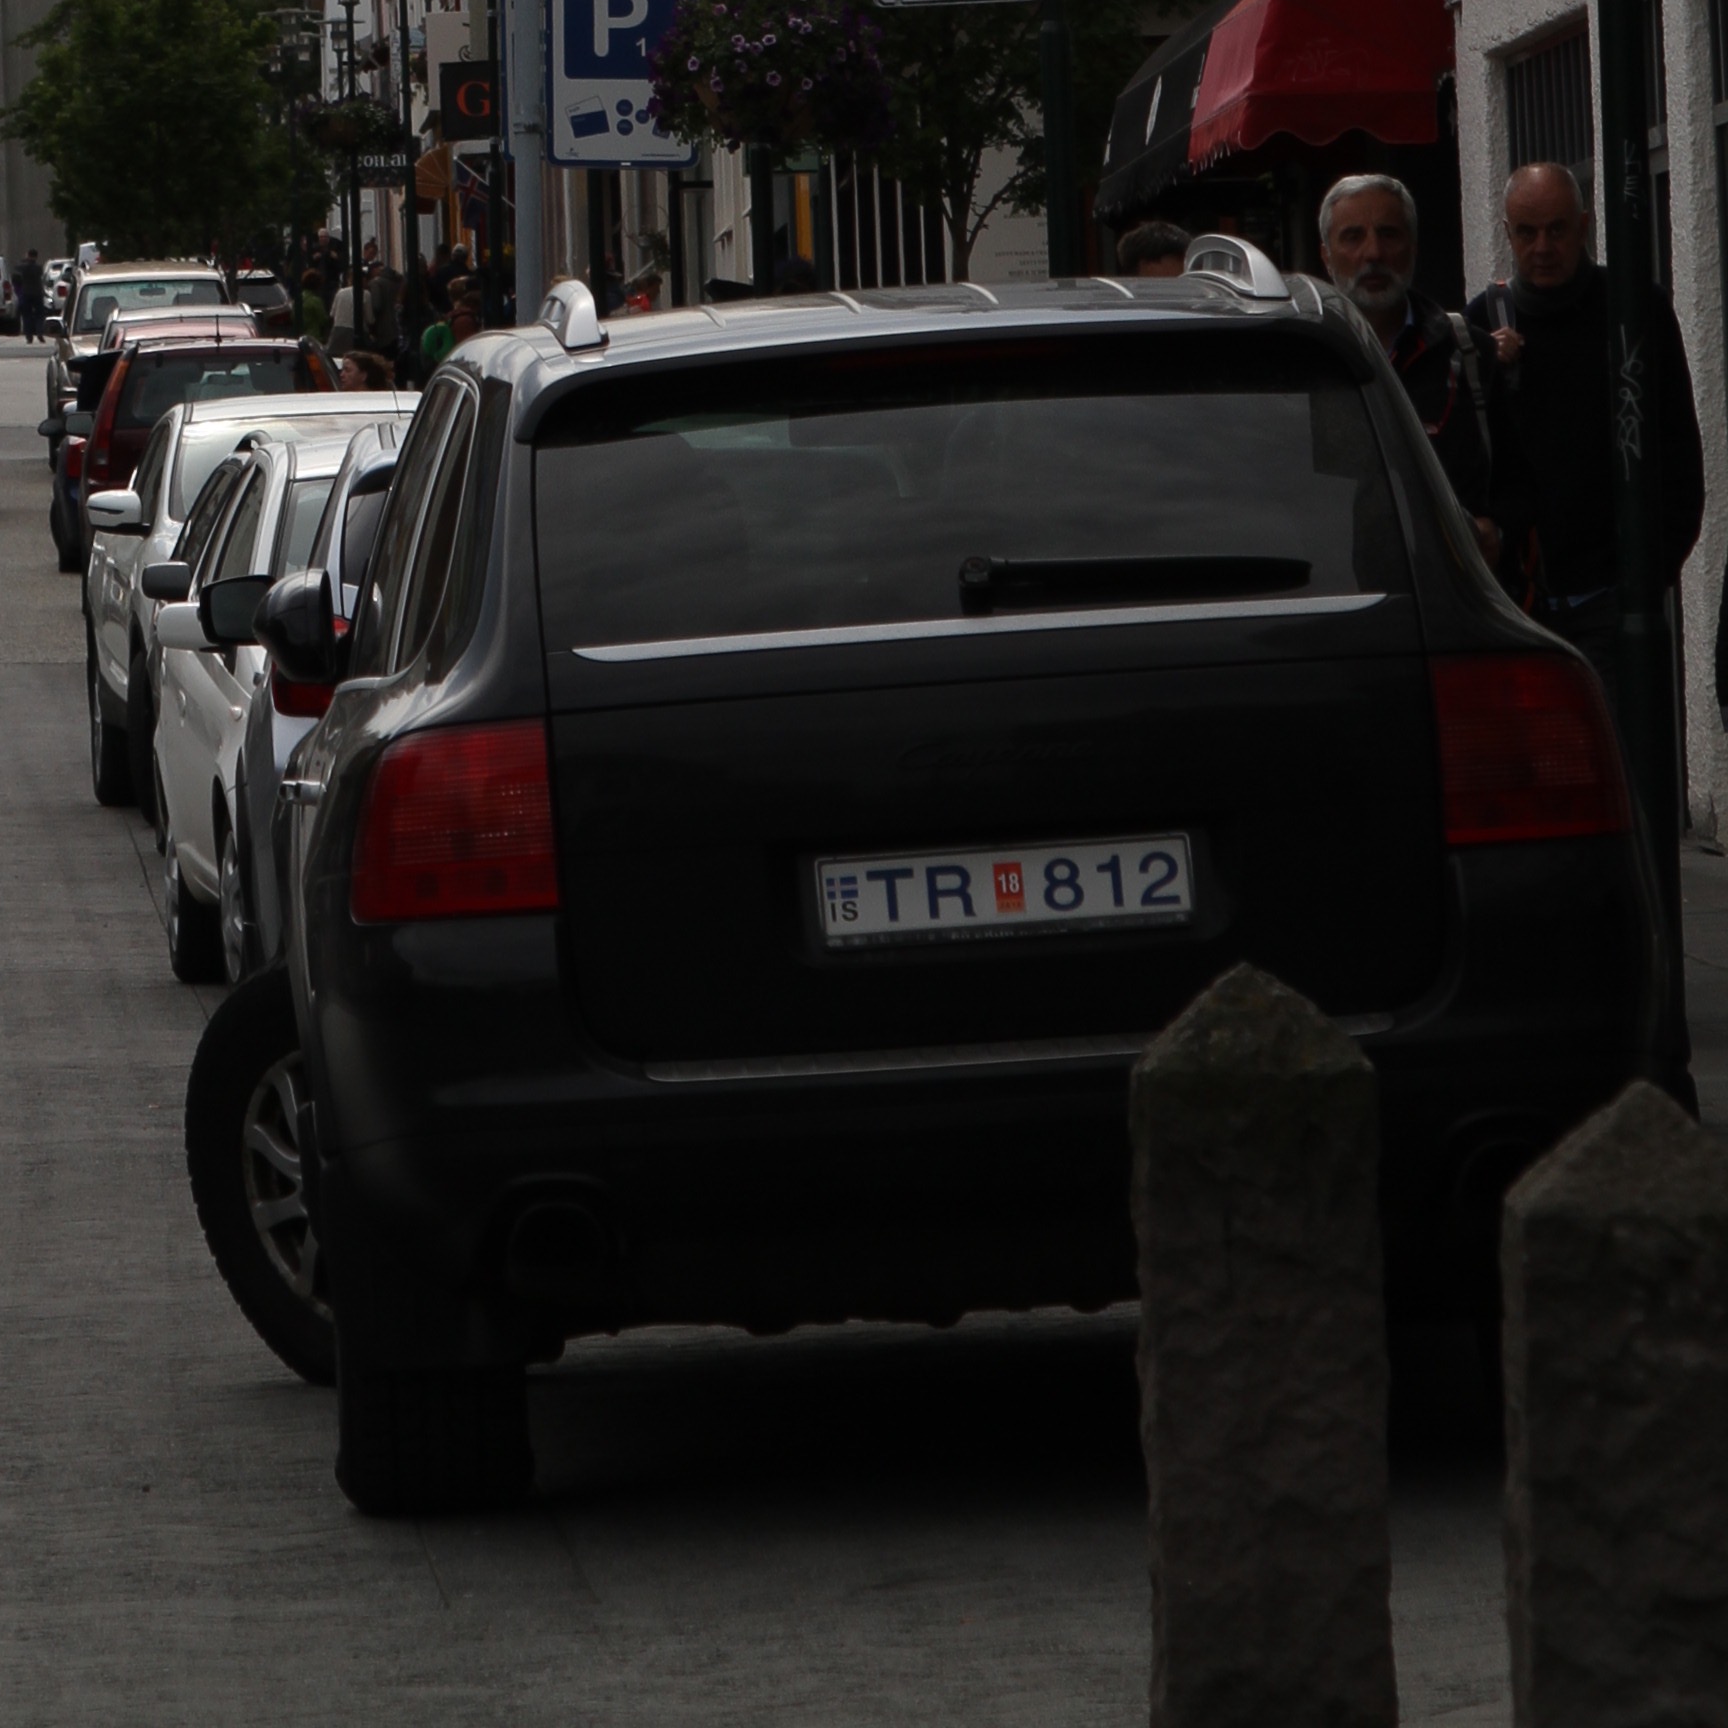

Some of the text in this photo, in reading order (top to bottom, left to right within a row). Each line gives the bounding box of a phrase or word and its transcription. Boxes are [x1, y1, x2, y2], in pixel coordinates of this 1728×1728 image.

[866, 851, 1181, 923] TR 18 812
[830, 900, 858, 922] IS
